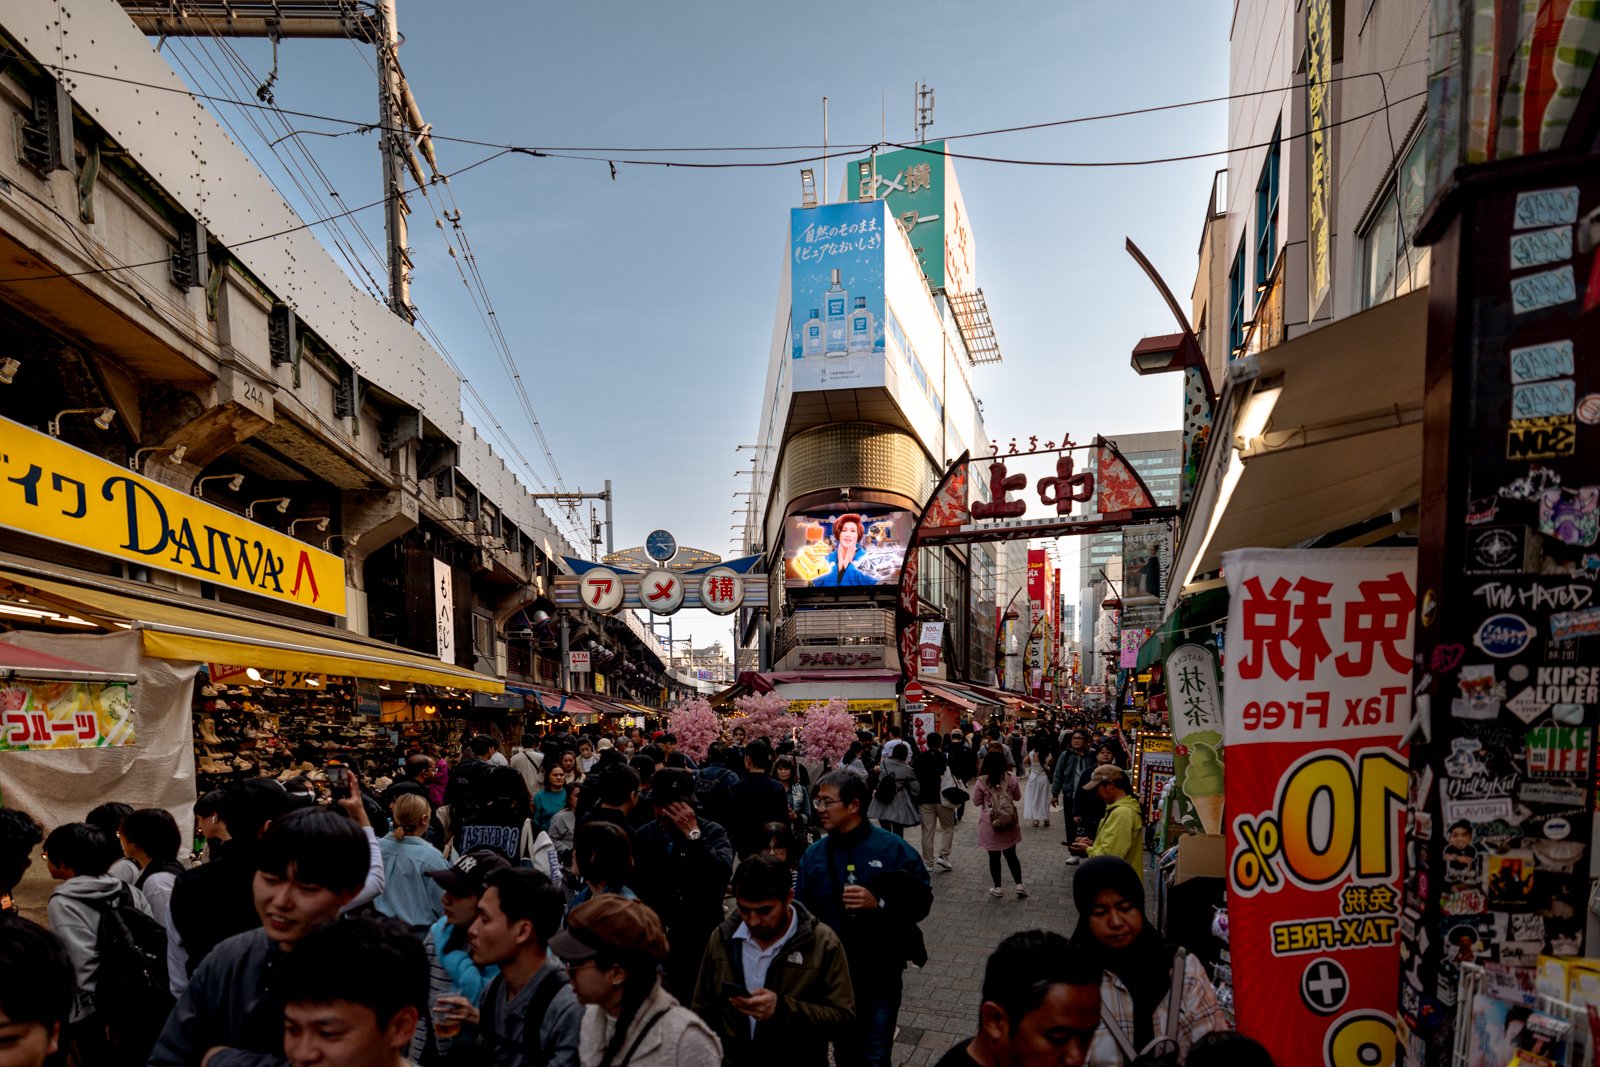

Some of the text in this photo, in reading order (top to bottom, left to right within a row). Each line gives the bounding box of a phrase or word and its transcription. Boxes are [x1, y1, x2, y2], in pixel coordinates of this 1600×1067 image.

[244, 381, 264, 409] 244
[0, 454, 87, 519] イワ
[971, 455, 1095, 519] 上中
[101, 476, 284, 594] DAIWA
[1124, 535, 1155, 543] MASTERS
[587, 576, 735, 606] アメ横
[799, 652, 882, 667] アメ横センター
[0, 712, 97, 742] フルーツ
[1526, 726, 1590, 750] MIKE
